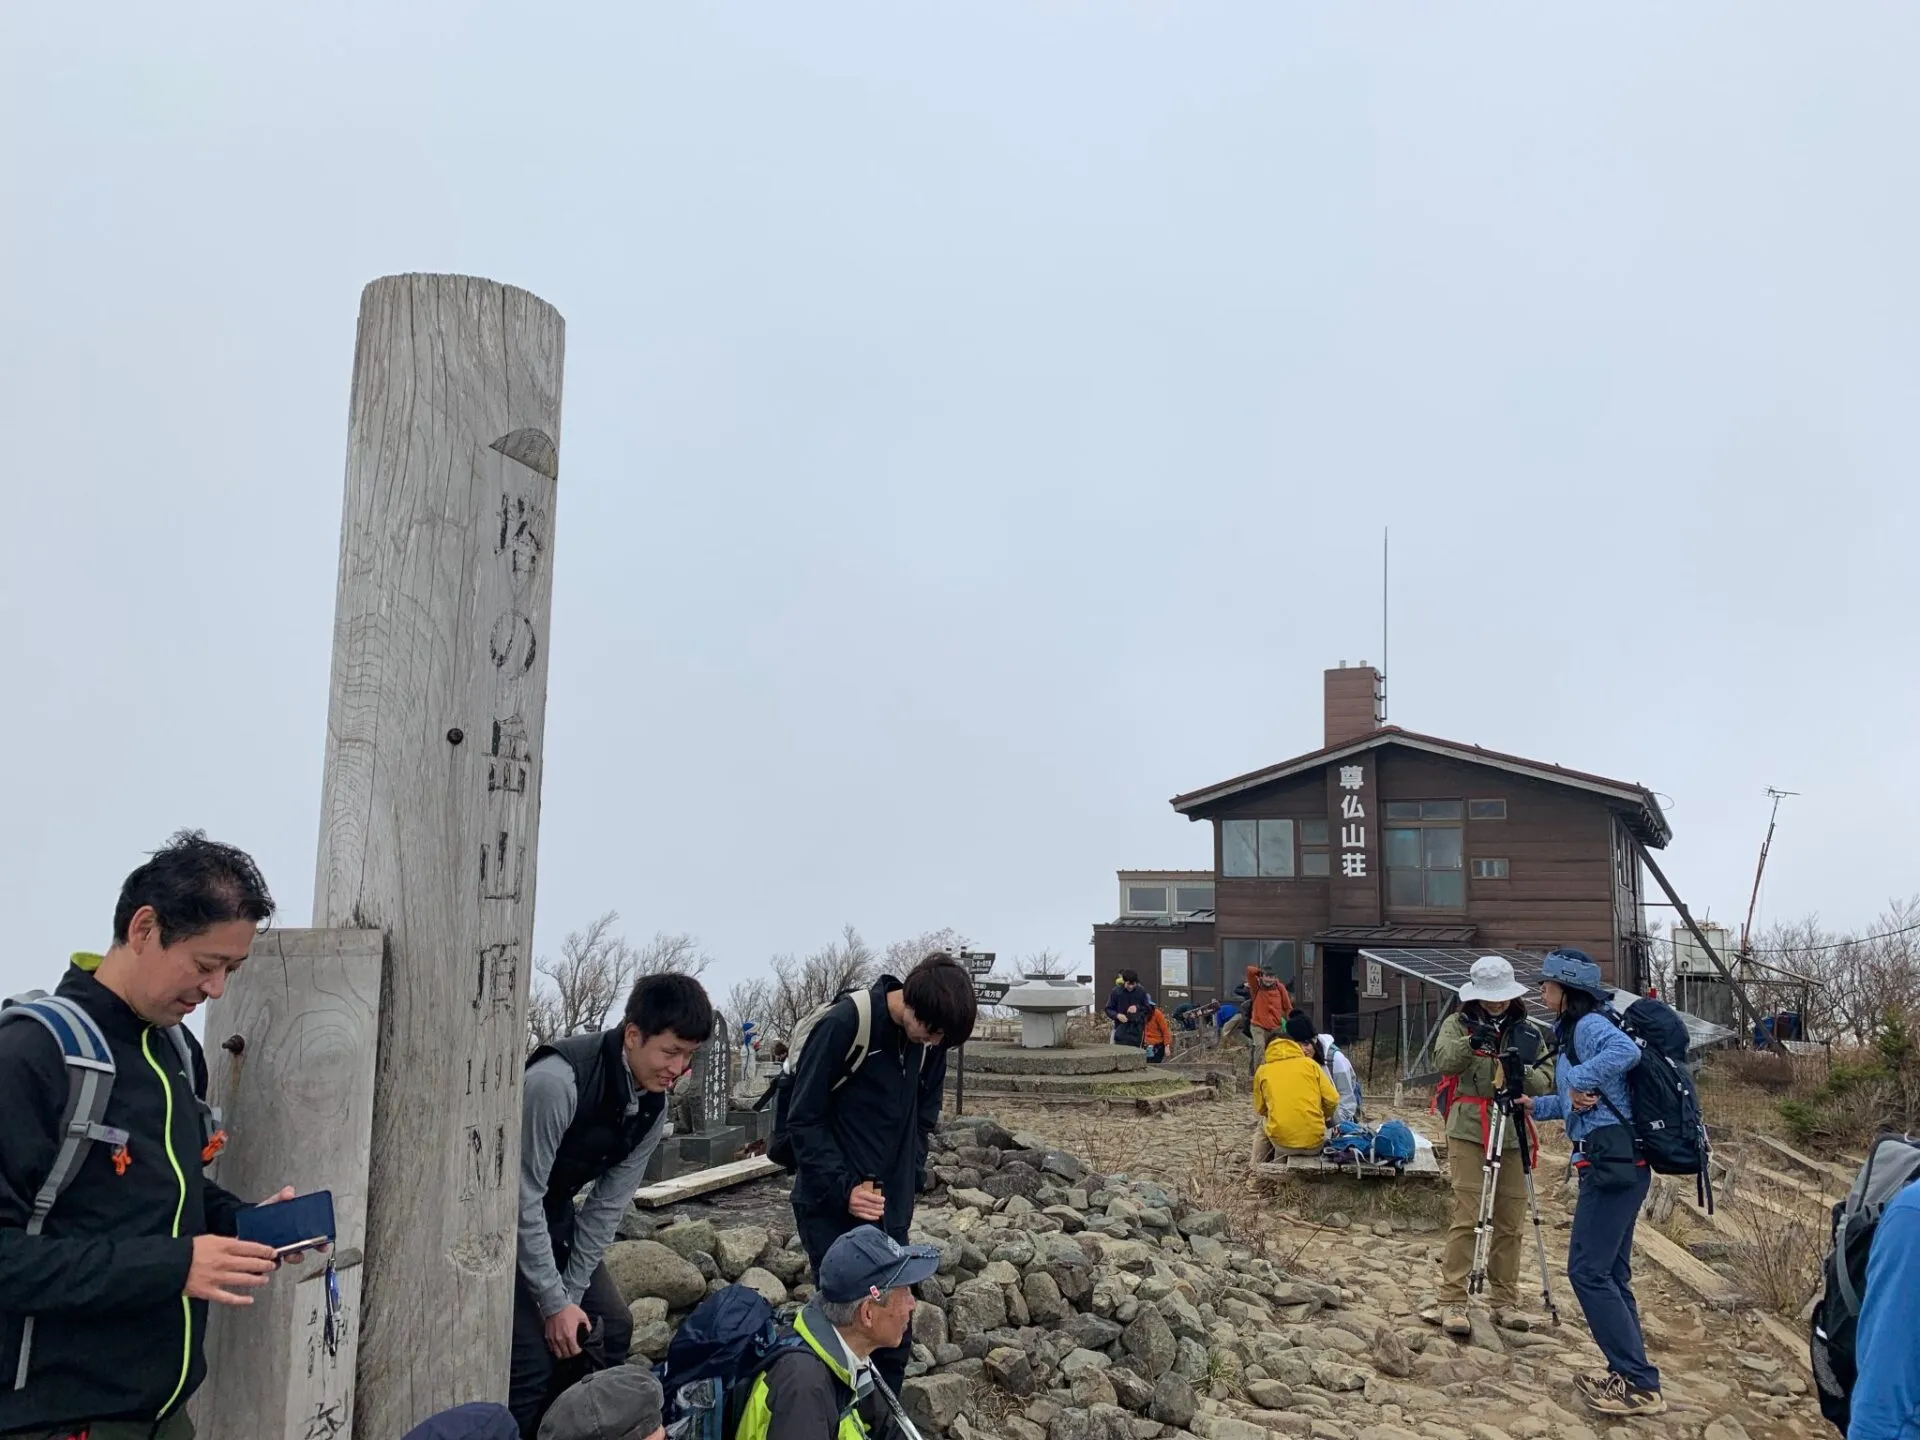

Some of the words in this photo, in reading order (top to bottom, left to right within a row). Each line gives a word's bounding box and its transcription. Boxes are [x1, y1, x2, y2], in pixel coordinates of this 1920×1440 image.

[1340, 765, 1366, 877] 尊仏山荘
[465, 1051, 515, 1095] 1491
